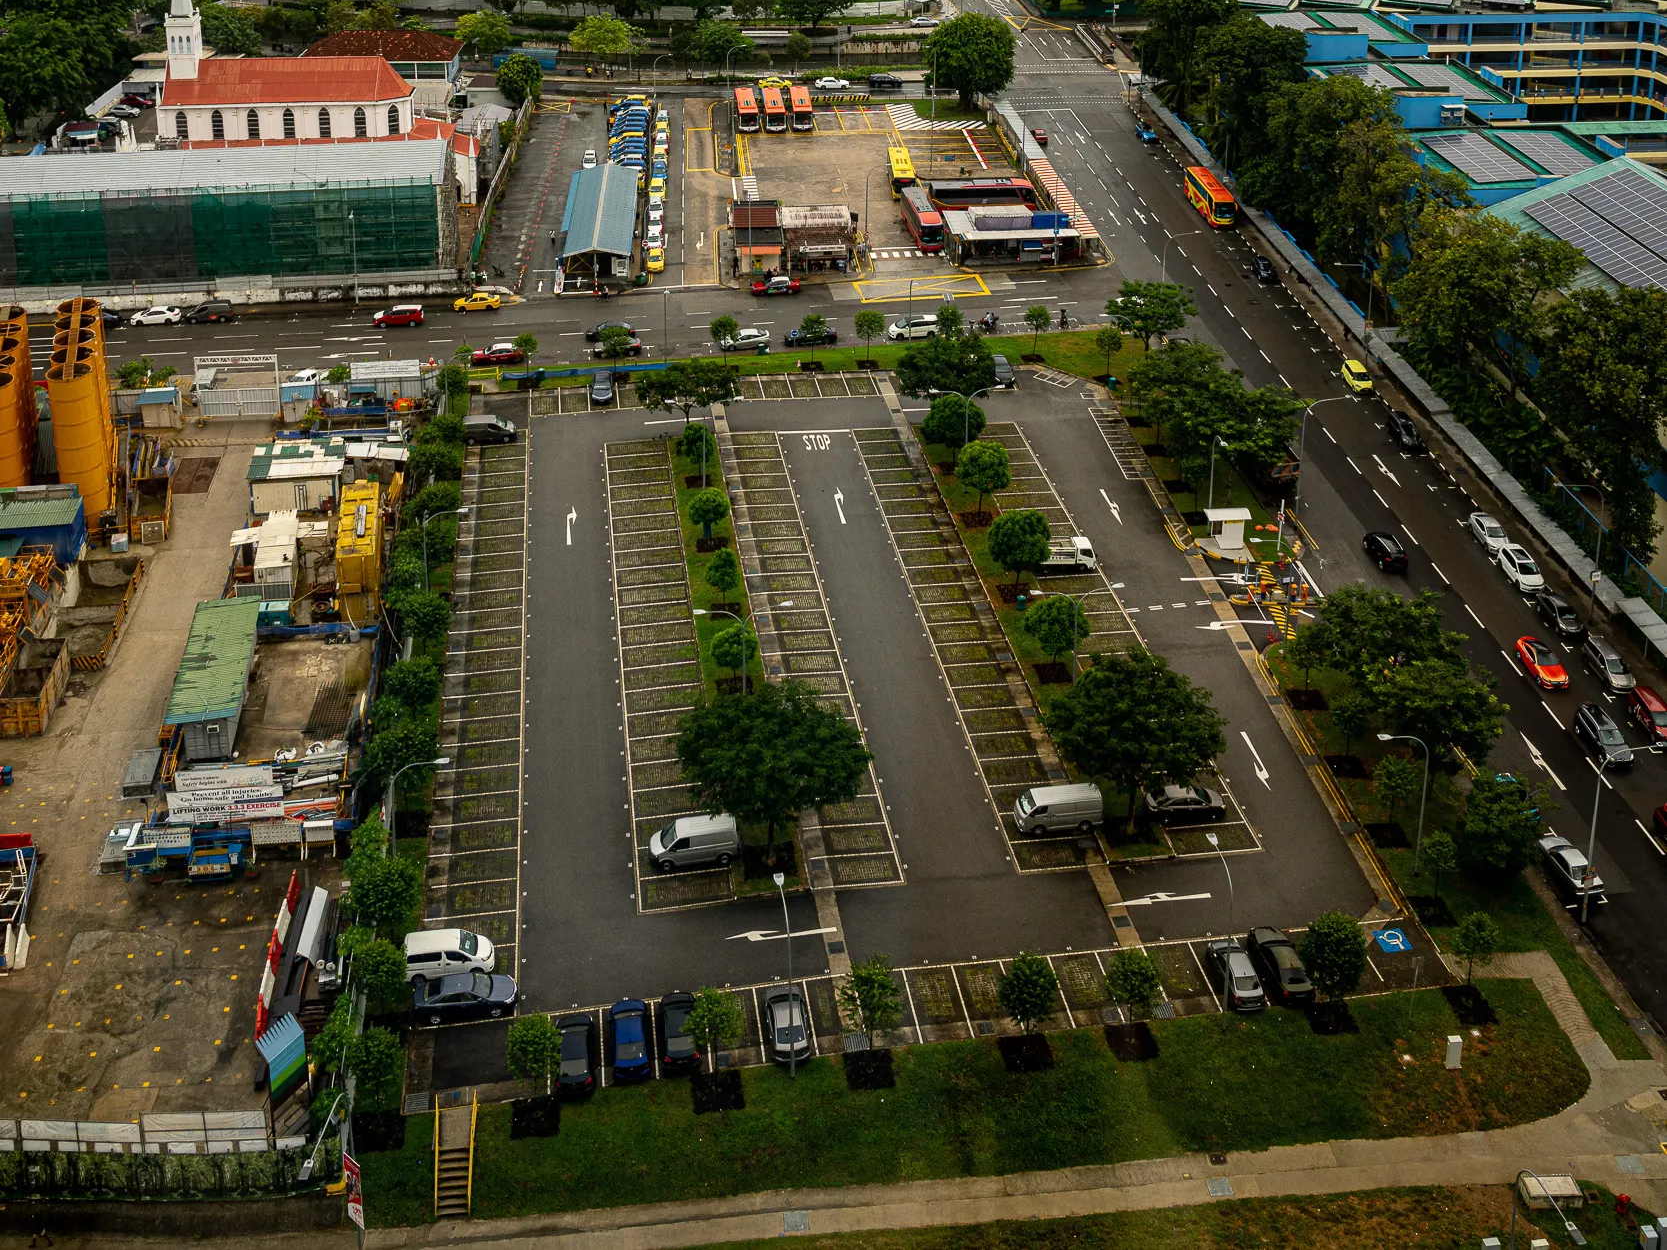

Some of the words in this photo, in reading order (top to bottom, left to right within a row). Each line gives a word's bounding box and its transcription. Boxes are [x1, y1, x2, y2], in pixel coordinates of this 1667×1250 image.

[802, 434, 831, 450] STOP
[173, 807, 202, 815] LIFTING
[227, 803, 245, 811] 3.3.3
